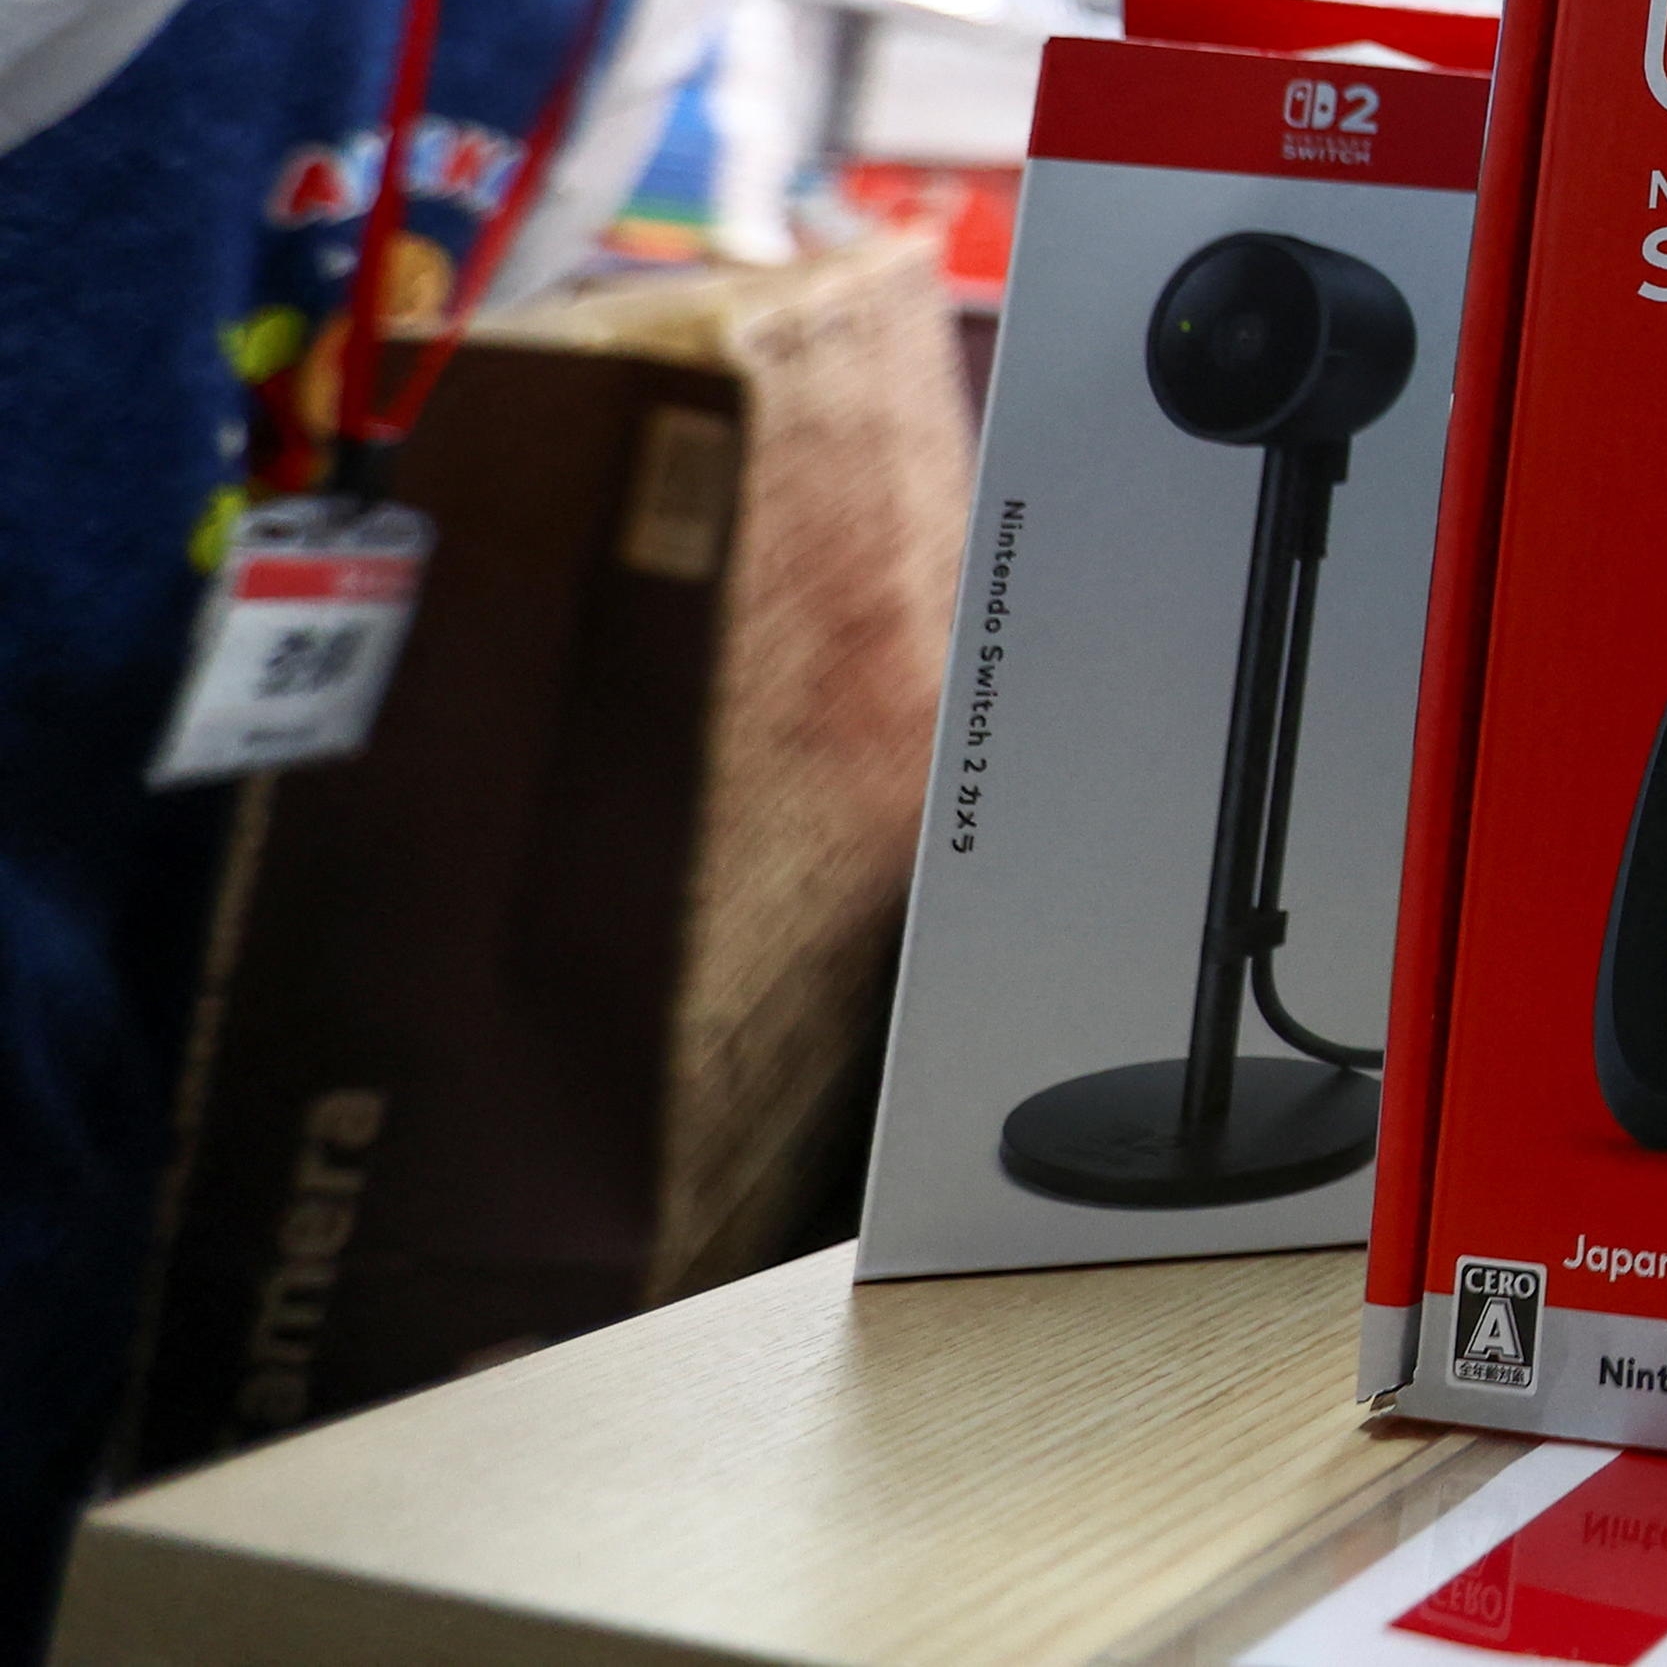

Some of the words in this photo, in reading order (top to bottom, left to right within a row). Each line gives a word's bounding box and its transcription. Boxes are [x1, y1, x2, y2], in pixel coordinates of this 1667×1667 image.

[1339, 84, 1380, 134] 2
[985, 500, 1027, 634] Nintendo
[967, 645, 1003, 747] Switch
[963, 757, 987, 773] 2
[952, 784, 981, 854] カメラ
[212, 1086, 388, 1452] amera
[1465, 1267, 1537, 1299] CERO
[1464, 1296, 1526, 1363] A
